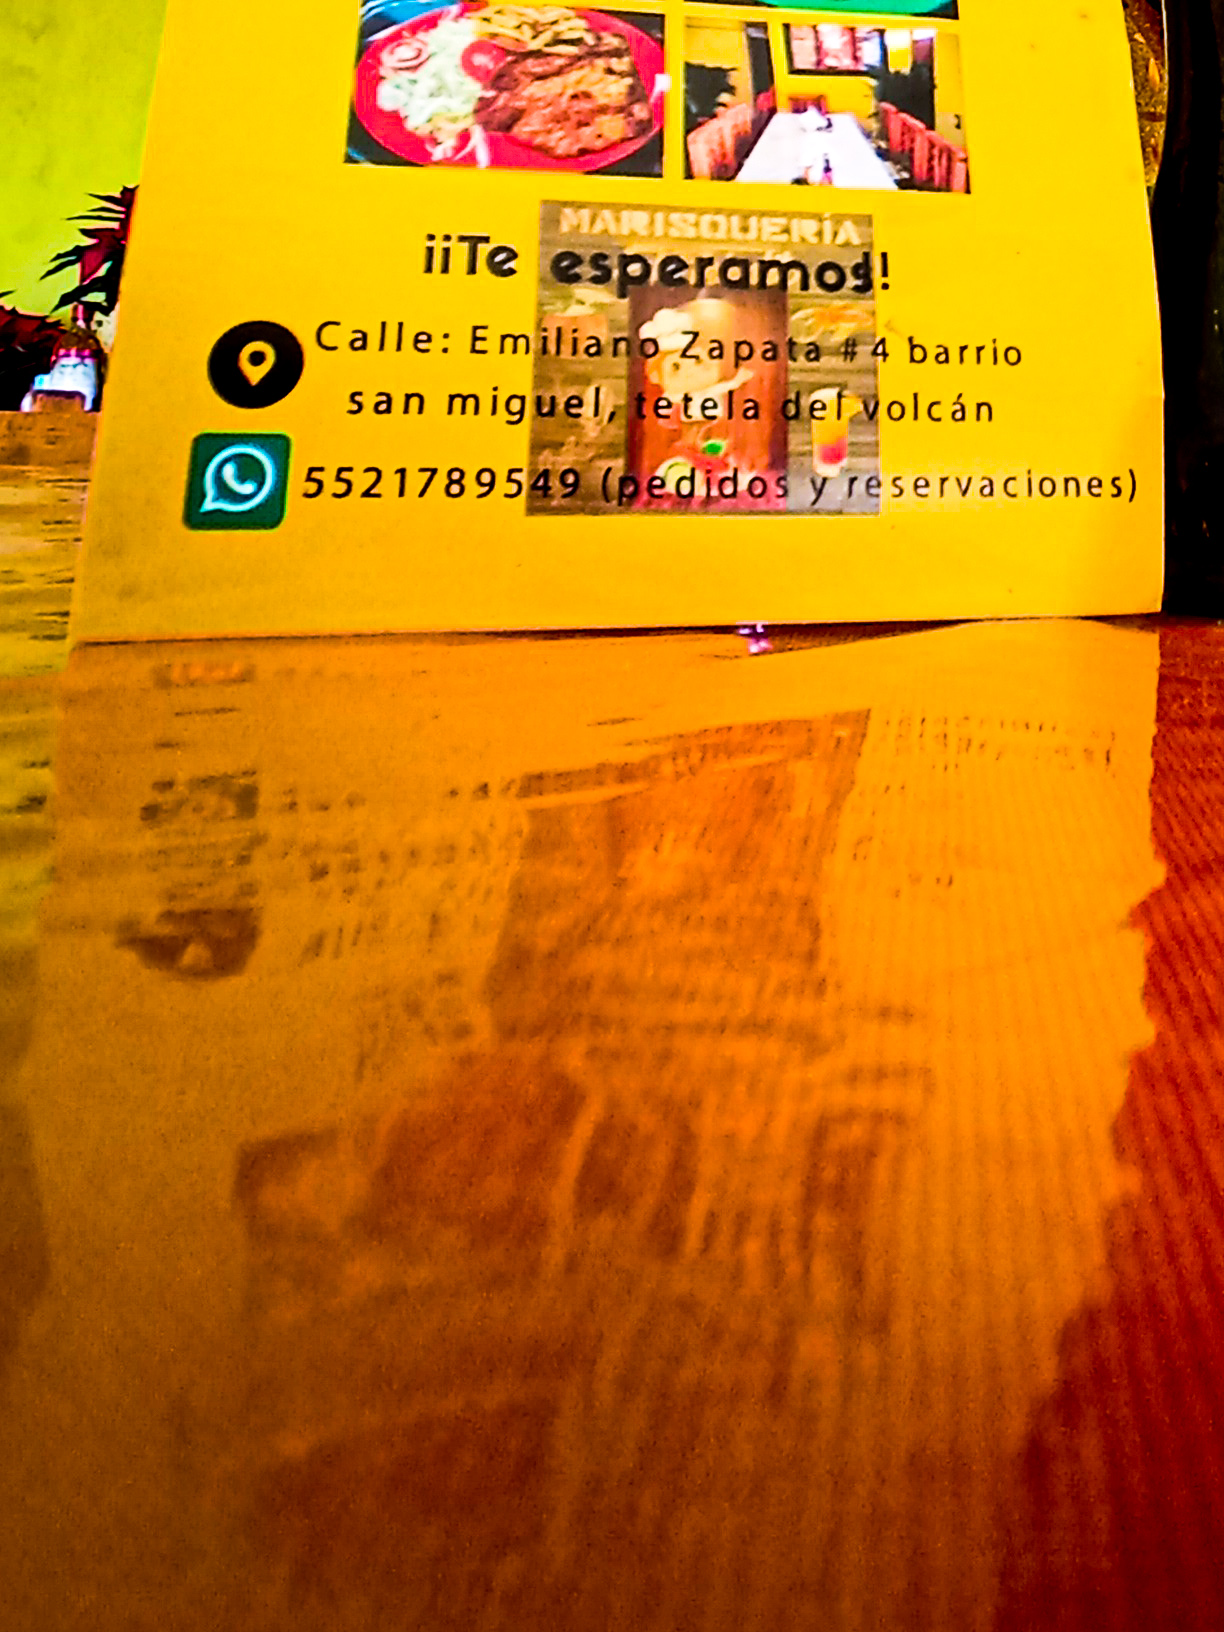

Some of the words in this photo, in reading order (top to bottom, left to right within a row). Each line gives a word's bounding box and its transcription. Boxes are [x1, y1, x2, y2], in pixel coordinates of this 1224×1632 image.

[559, 207, 862, 246] MARISQUERÍA
[315, 320, 450, 354] Calle:
[469, 324, 660, 360] Emiliano
[679, 331, 821, 369] Zapata
[908, 336, 1022, 366] barrio
[346, 390, 425, 415] san
[447, 386, 616, 425] miguel,
[635, 390, 760, 420] tetela
[781, 391, 843, 421] del
[861, 392, 994, 423] volcán
[302, 465, 580, 499] 5521789549
[602, 466, 788, 506] (pedidos
[810, 479, 827, 506] y
[848, 467, 1137, 503] reservaciones)
